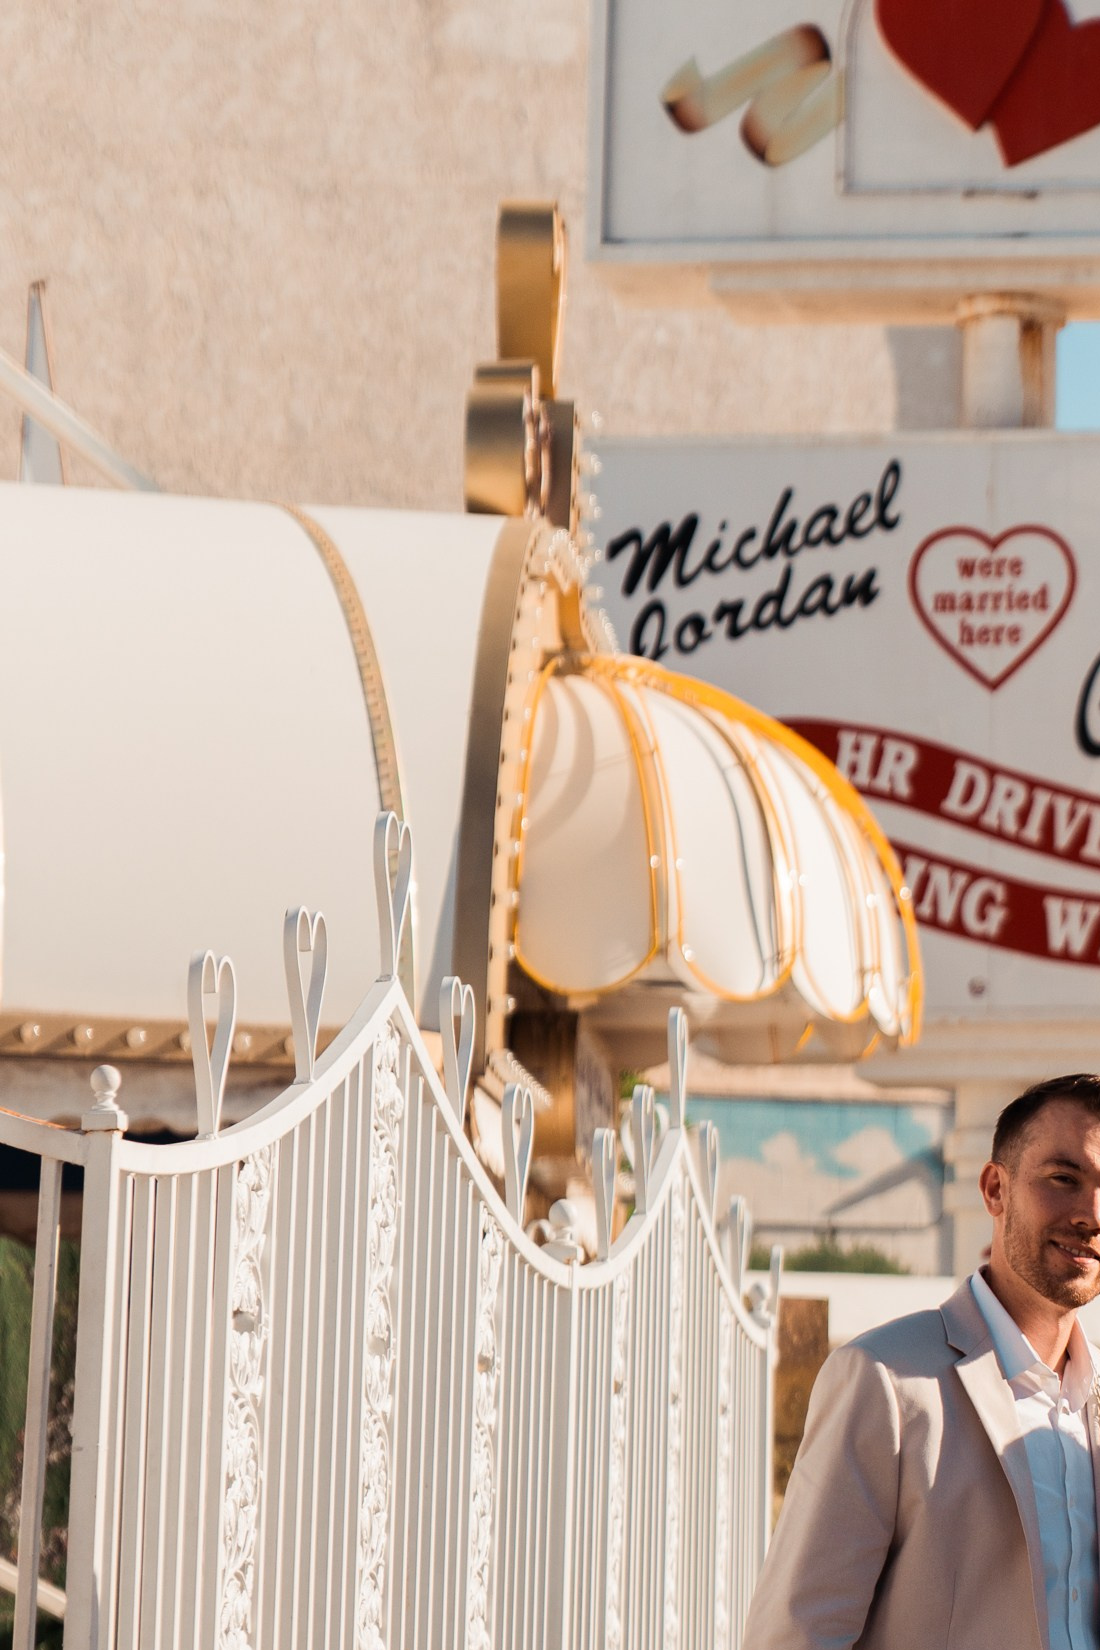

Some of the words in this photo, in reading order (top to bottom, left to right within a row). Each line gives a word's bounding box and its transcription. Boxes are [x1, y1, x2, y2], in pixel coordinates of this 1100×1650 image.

[606, 458, 902, 597] Michael
[958, 557, 1024, 579] were
[629, 561, 880, 661] Jordan
[934, 583, 1049, 613] married
[959, 617, 1022, 646] here
[836, 730, 918, 798] HR
